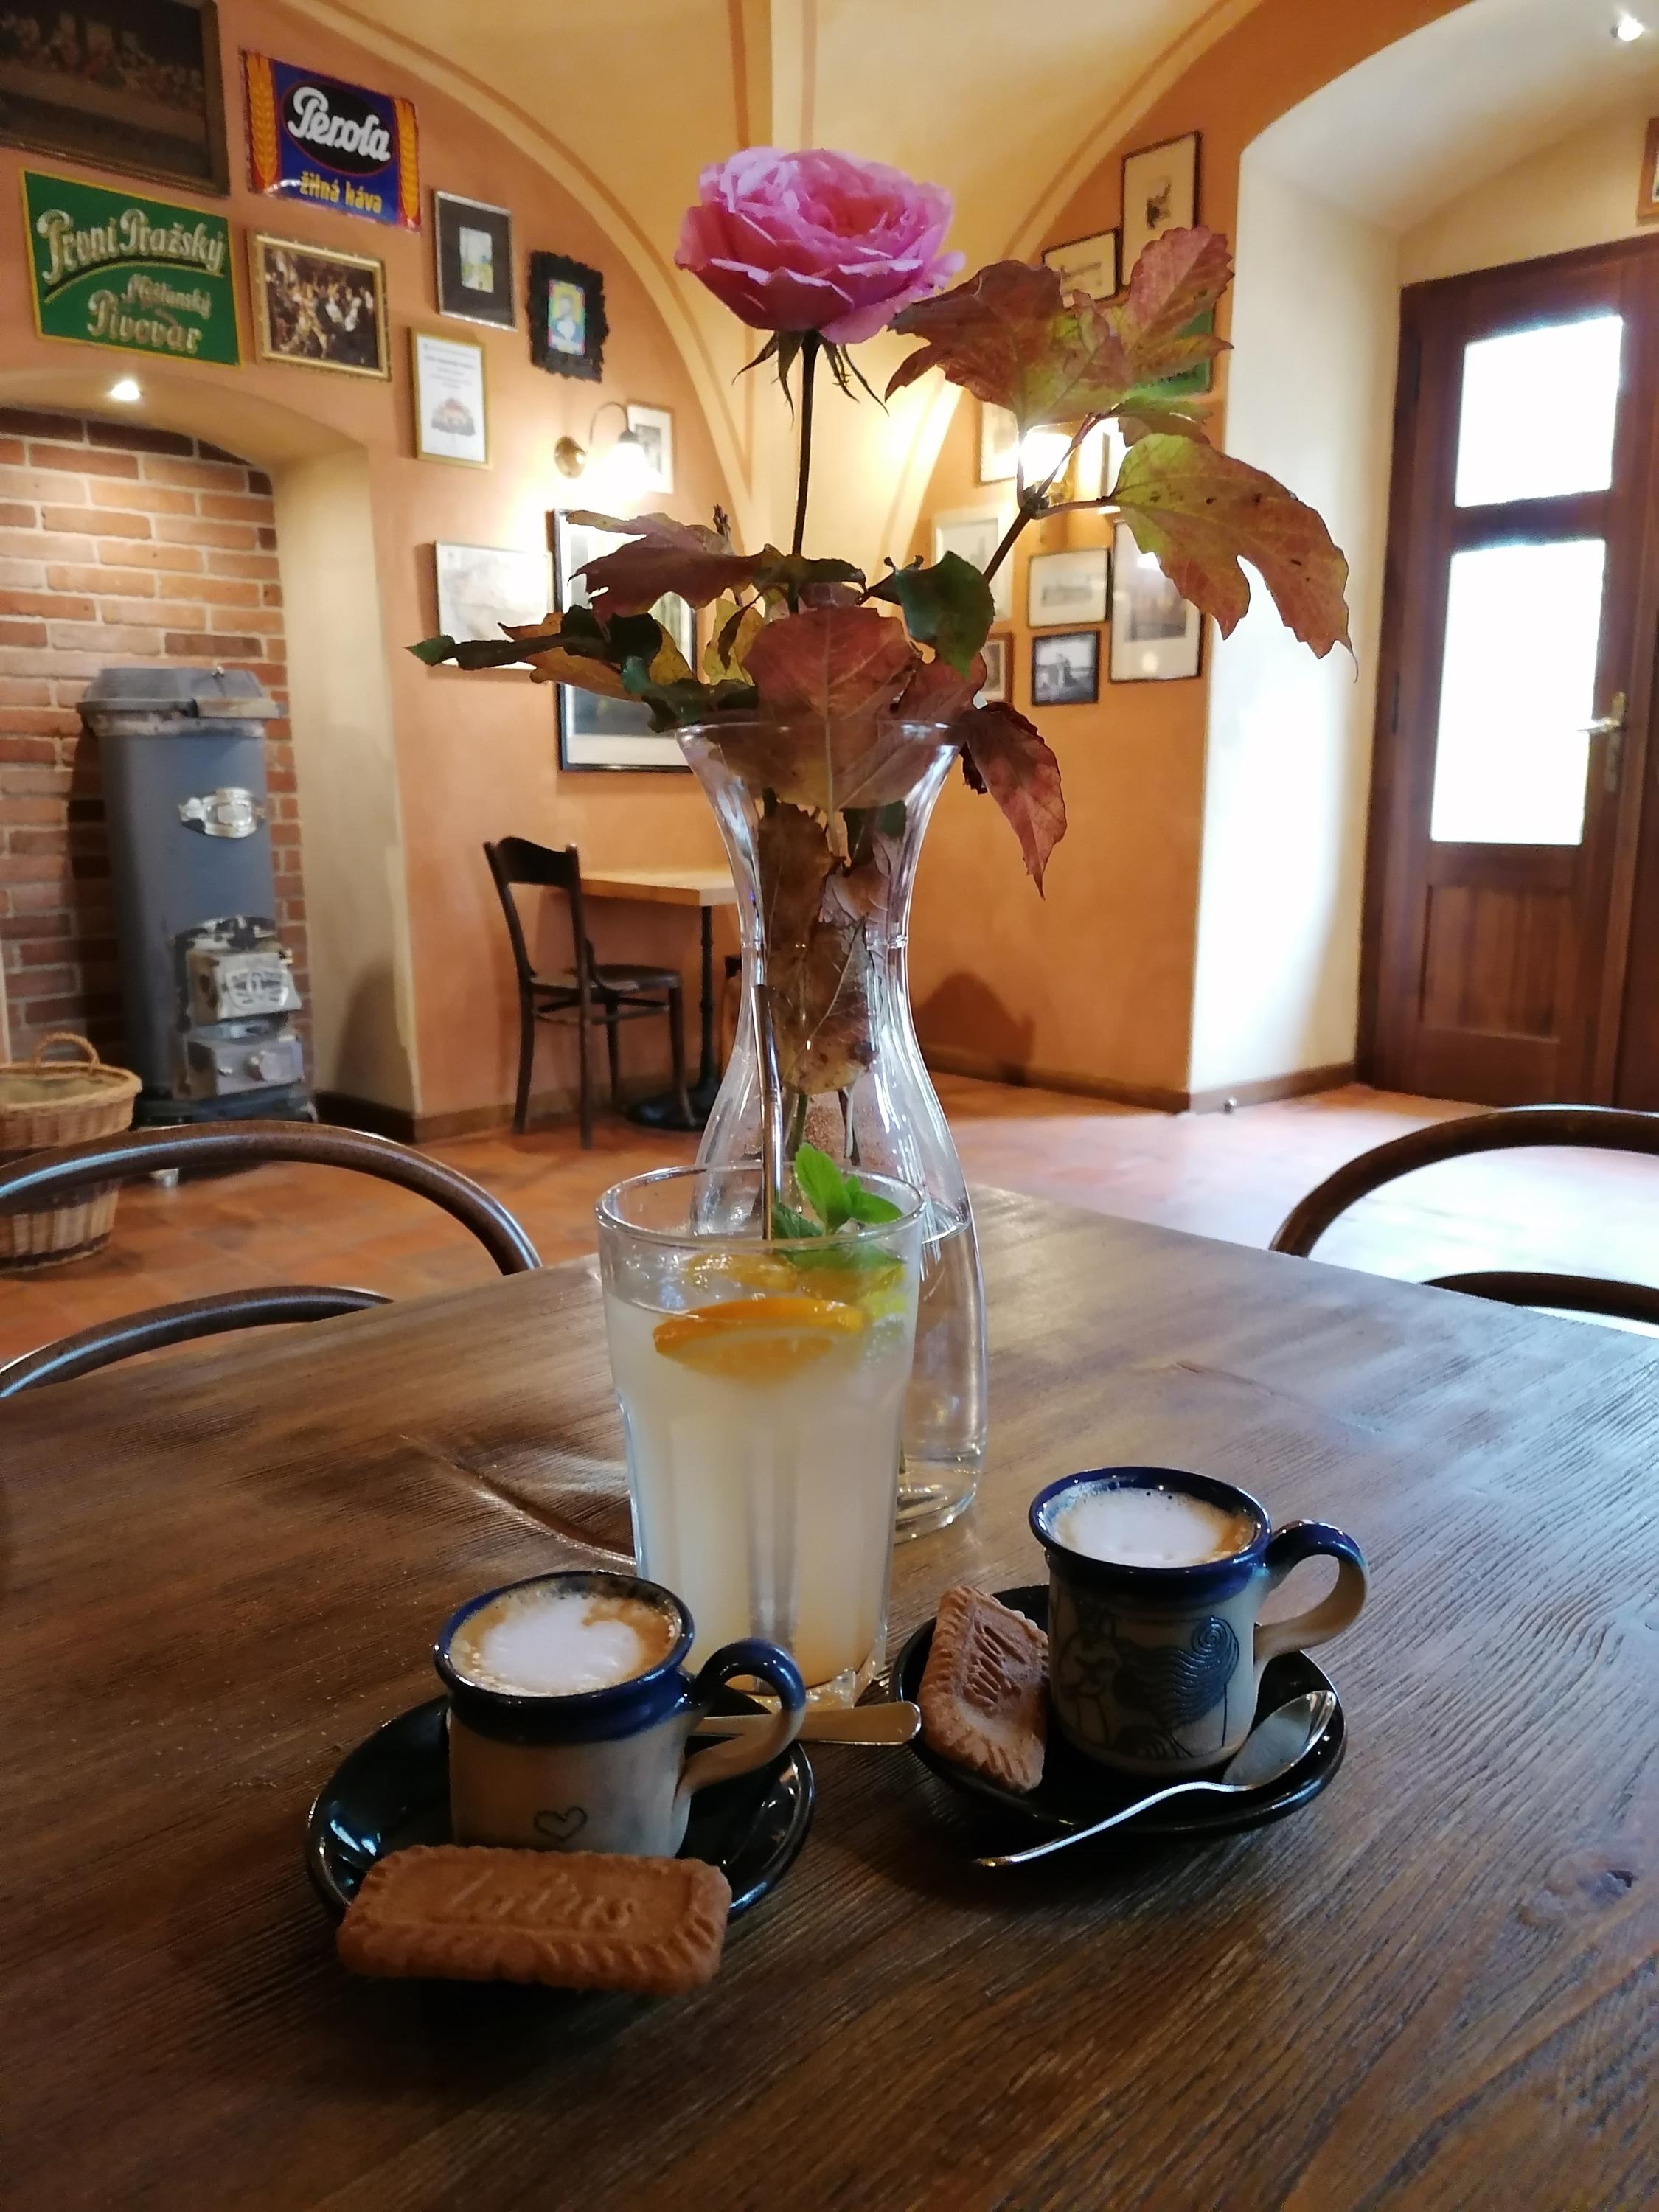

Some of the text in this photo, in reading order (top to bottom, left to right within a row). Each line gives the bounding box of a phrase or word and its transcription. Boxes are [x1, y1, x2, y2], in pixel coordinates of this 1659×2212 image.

[287, 86, 392, 162] Perola
[345, 181, 382, 214] káva
[87, 289, 203, 354] Pivovar
